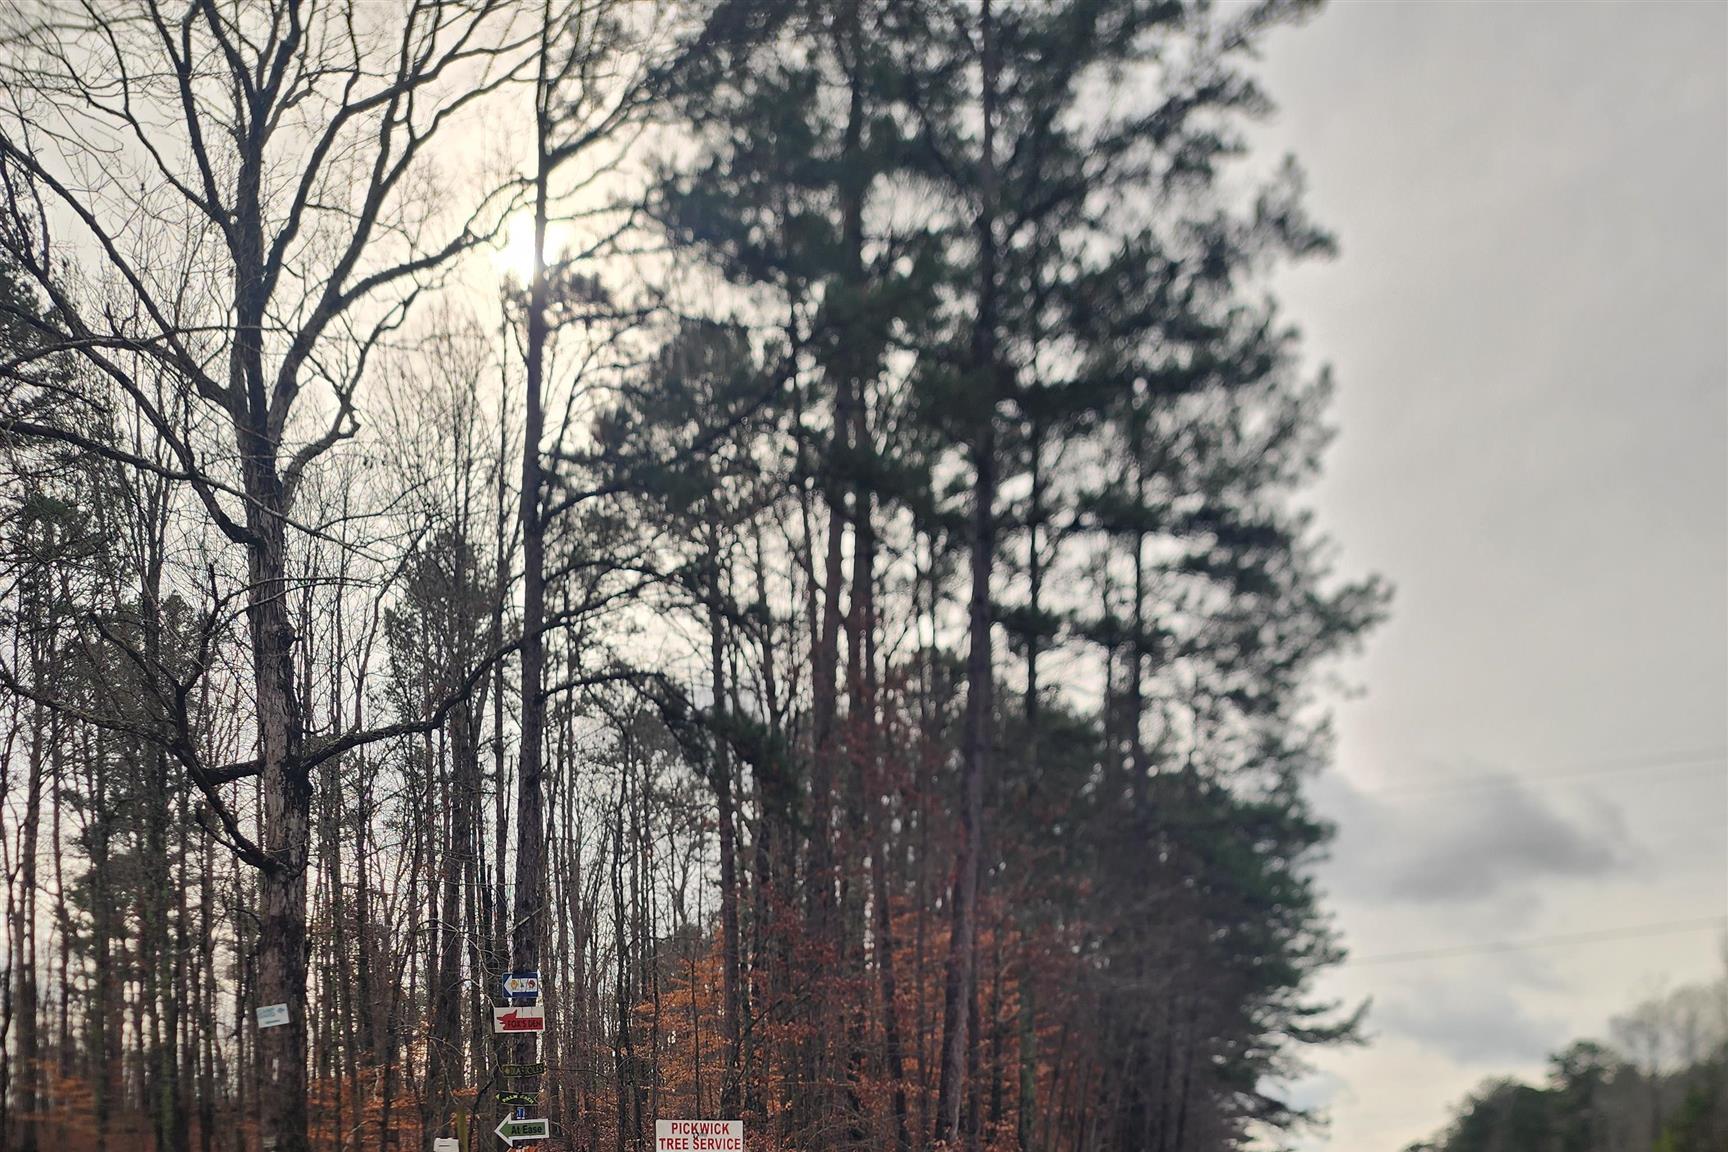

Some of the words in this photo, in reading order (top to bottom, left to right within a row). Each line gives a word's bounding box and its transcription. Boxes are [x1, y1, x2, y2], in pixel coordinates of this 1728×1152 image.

[511, 1125, 520, 1134] At
[522, 1124, 543, 1134] Ease
[671, 1122, 730, 1135] PICKWICK
[659, 1138, 689, 1150] TREE
[693, 1138, 741, 1150] SERVICE
